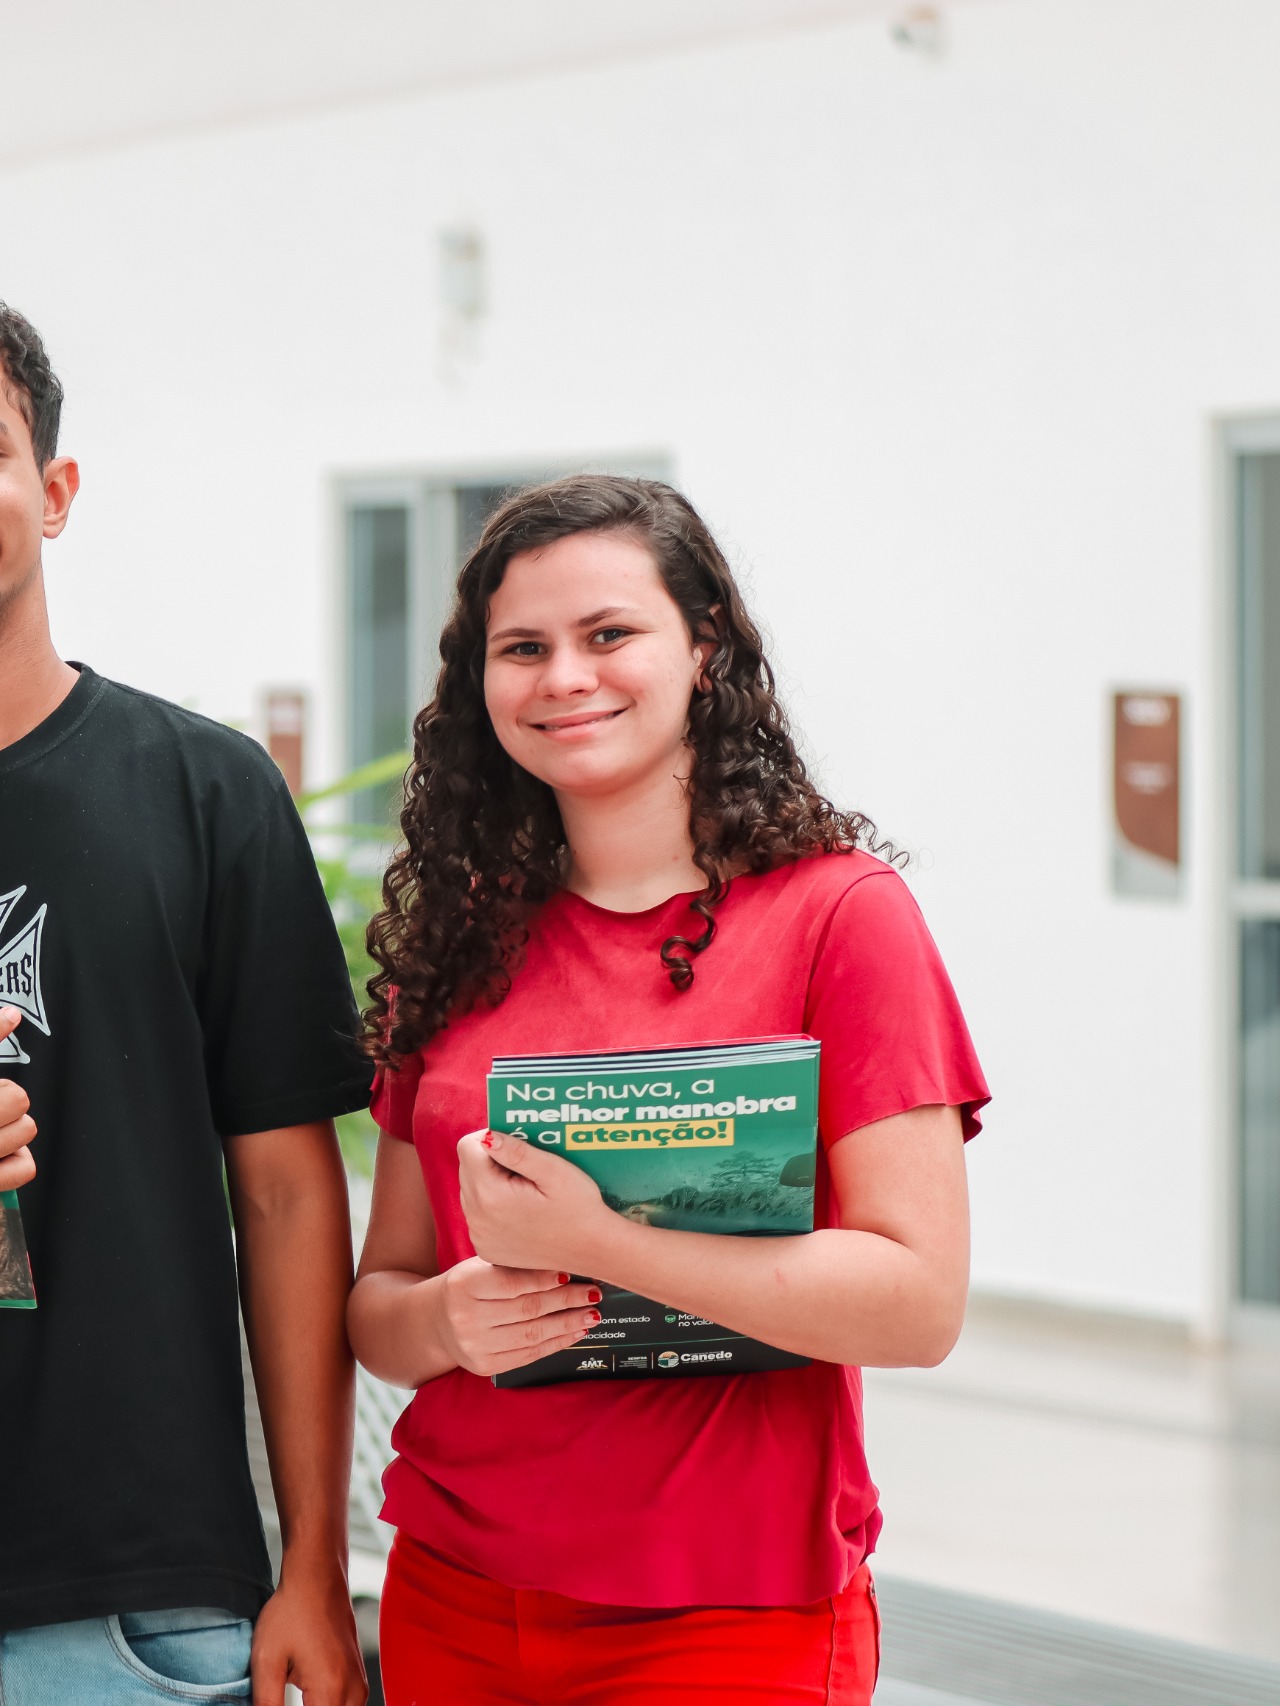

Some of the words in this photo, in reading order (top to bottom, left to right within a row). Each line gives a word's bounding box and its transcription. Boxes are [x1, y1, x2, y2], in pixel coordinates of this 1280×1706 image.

[506, 1083, 556, 1102] Na
[565, 1081, 681, 1100] chuva,
[690, 1079, 715, 1095] a
[505, 1103, 630, 1124] melhor
[635, 1095, 797, 1121] manobra
[537, 1130, 561, 1145] a
[570, 1121, 728, 1147] atenção!
[618, 1315, 651, 1323] estado
[583, 1331, 626, 1340] locidade
[680, 1350, 733, 1362] Canedo
[581, 1359, 604, 1368] SMT
